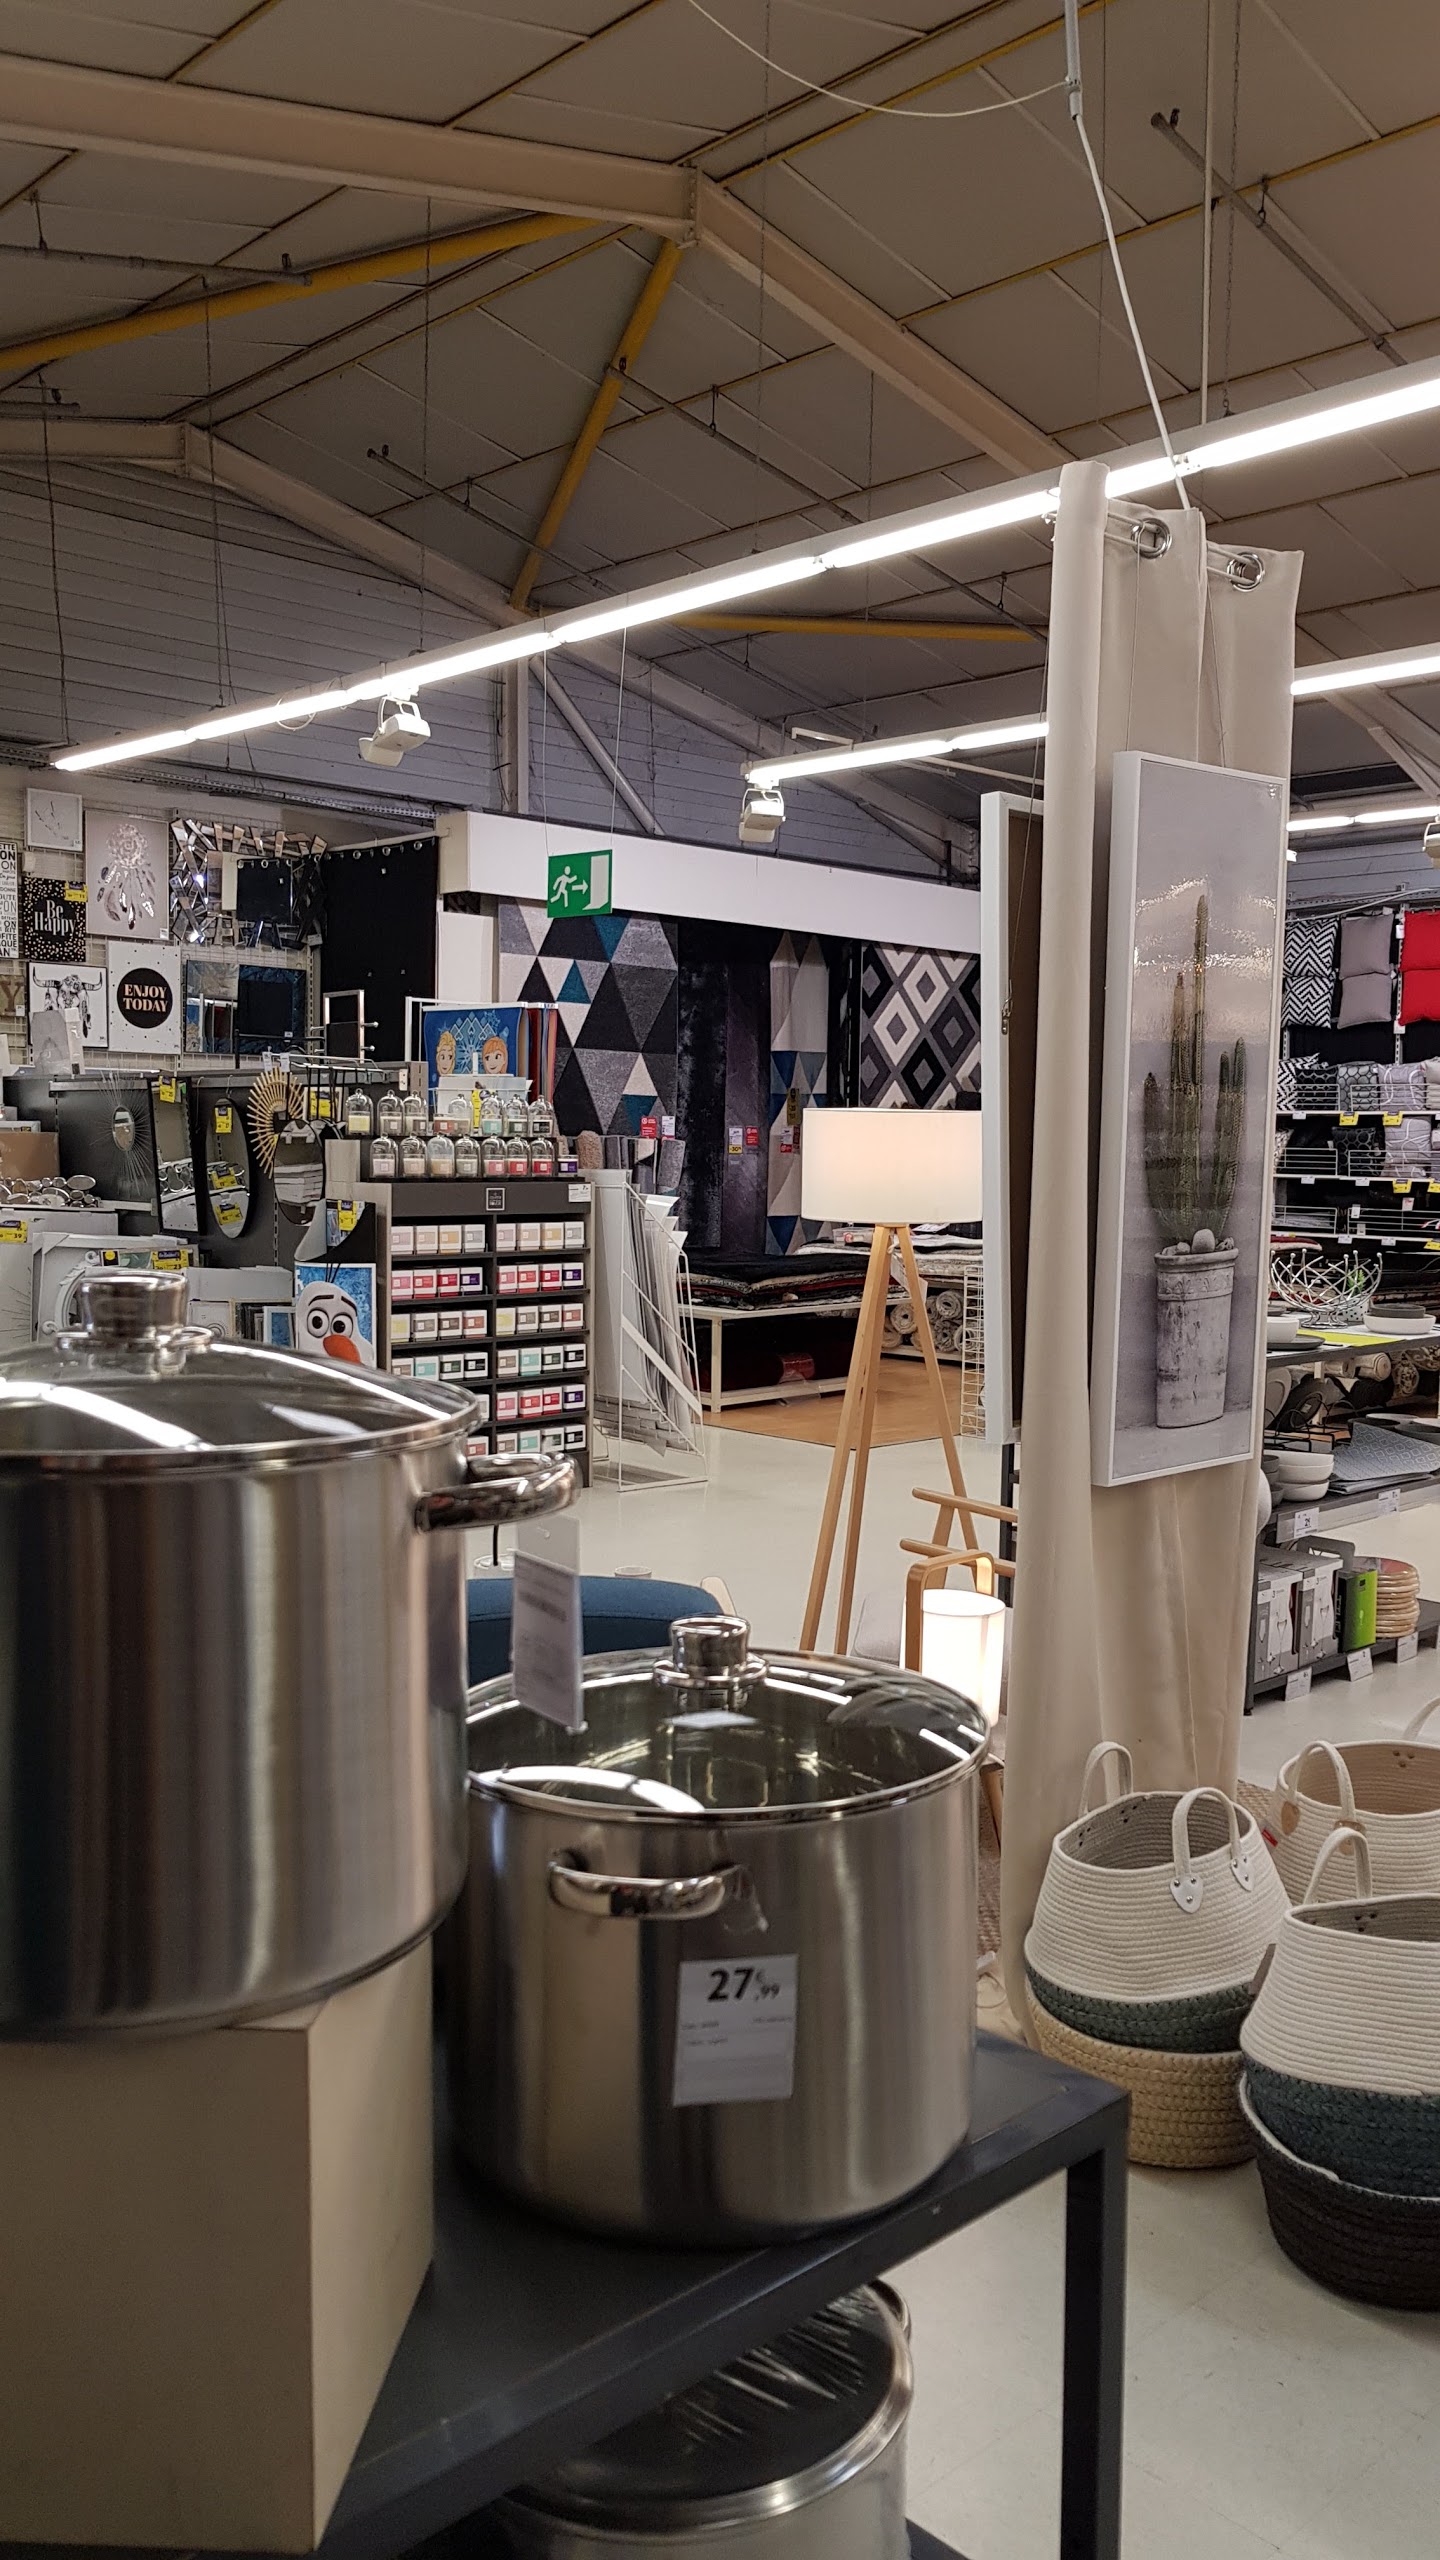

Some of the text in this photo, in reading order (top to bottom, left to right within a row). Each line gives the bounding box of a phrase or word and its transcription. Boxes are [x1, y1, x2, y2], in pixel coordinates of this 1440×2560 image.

[1, 860, 16, 870] ON
[46, 899, 64, 919] Be
[34, 911, 76, 937] Happy
[124, 983, 168, 999] ENJOY
[122, 997, 168, 1013] TODAY
